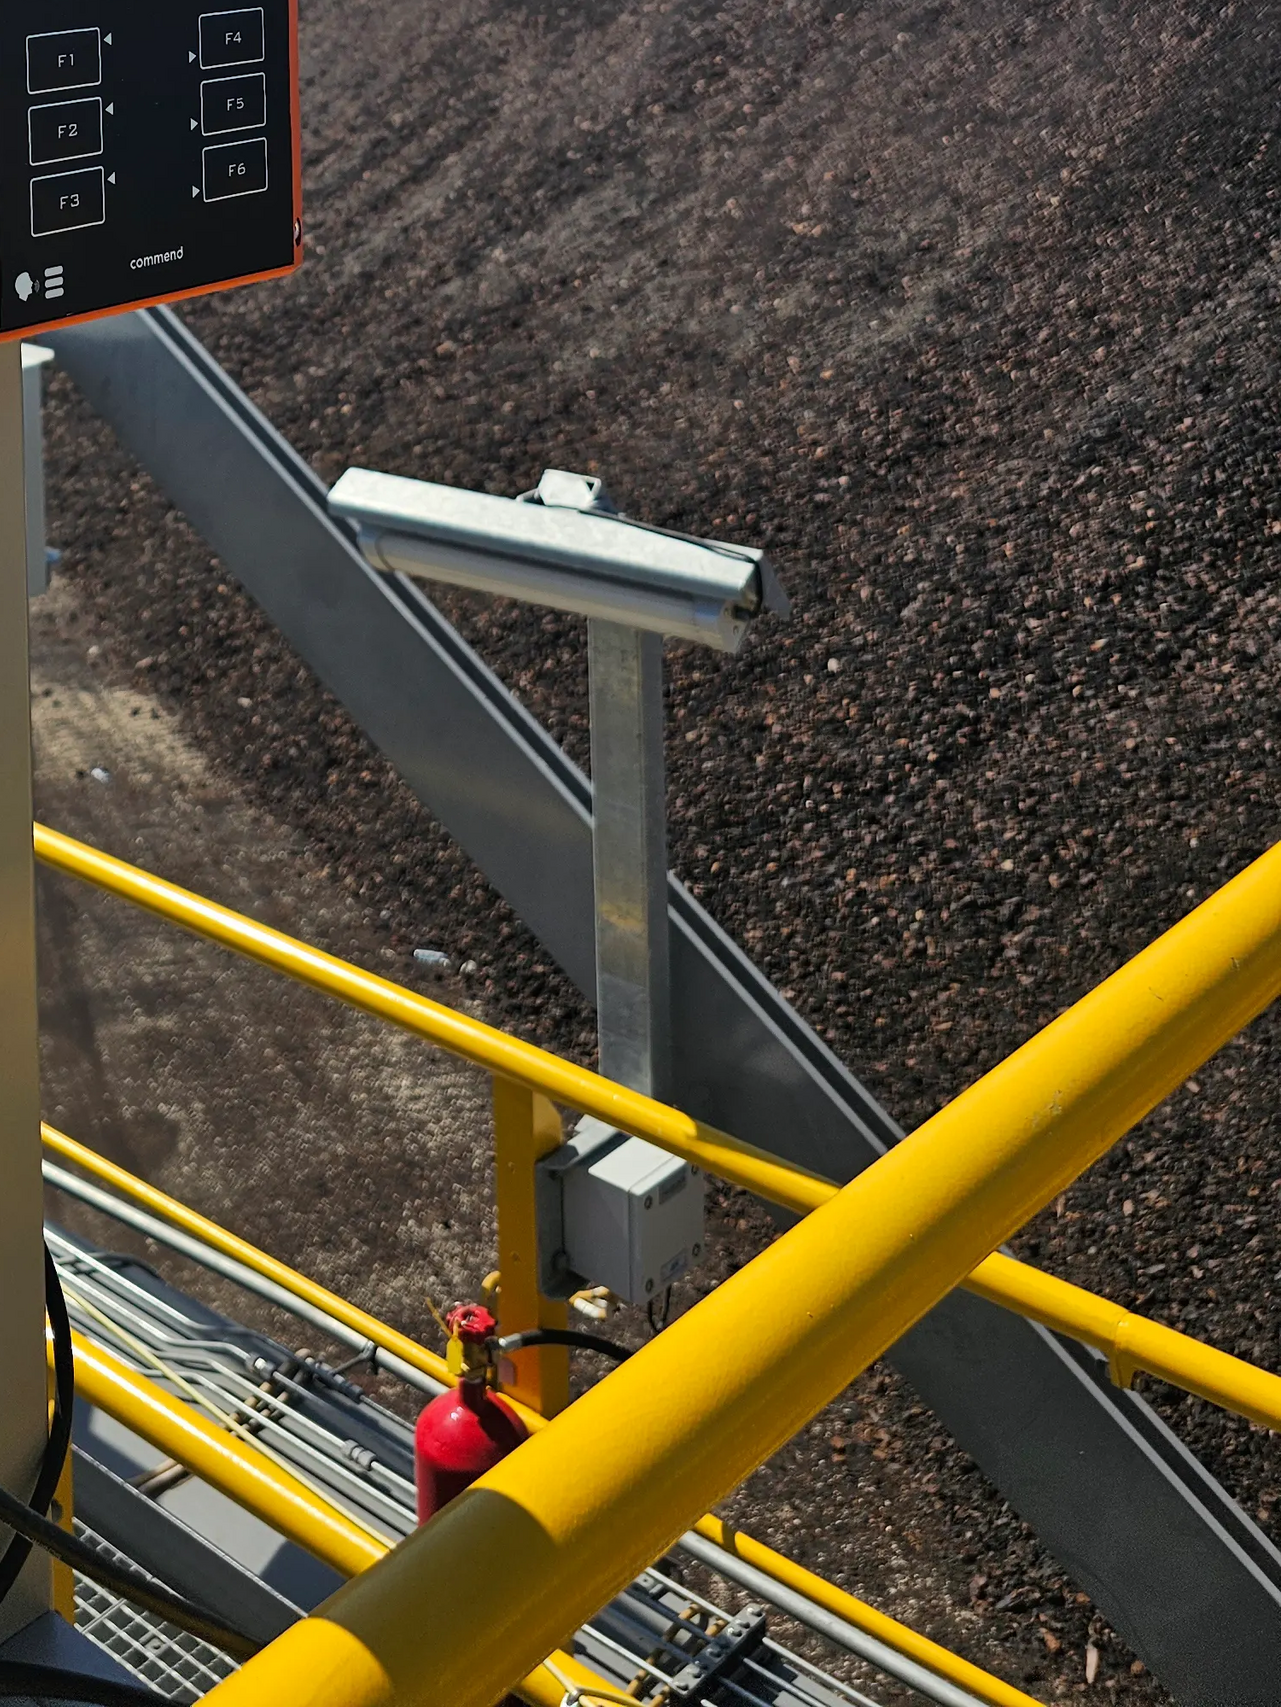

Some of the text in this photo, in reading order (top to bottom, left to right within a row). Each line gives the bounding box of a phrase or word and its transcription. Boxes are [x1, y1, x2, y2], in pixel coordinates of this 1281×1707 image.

[225, 31, 242, 45] F4
[58, 53, 75, 68] F1
[226, 97, 245, 112] F5
[58, 123, 78, 139] F2
[228, 162, 246, 177] F6
[59, 193, 80, 210] F3
[129, 245, 184, 270] commend
